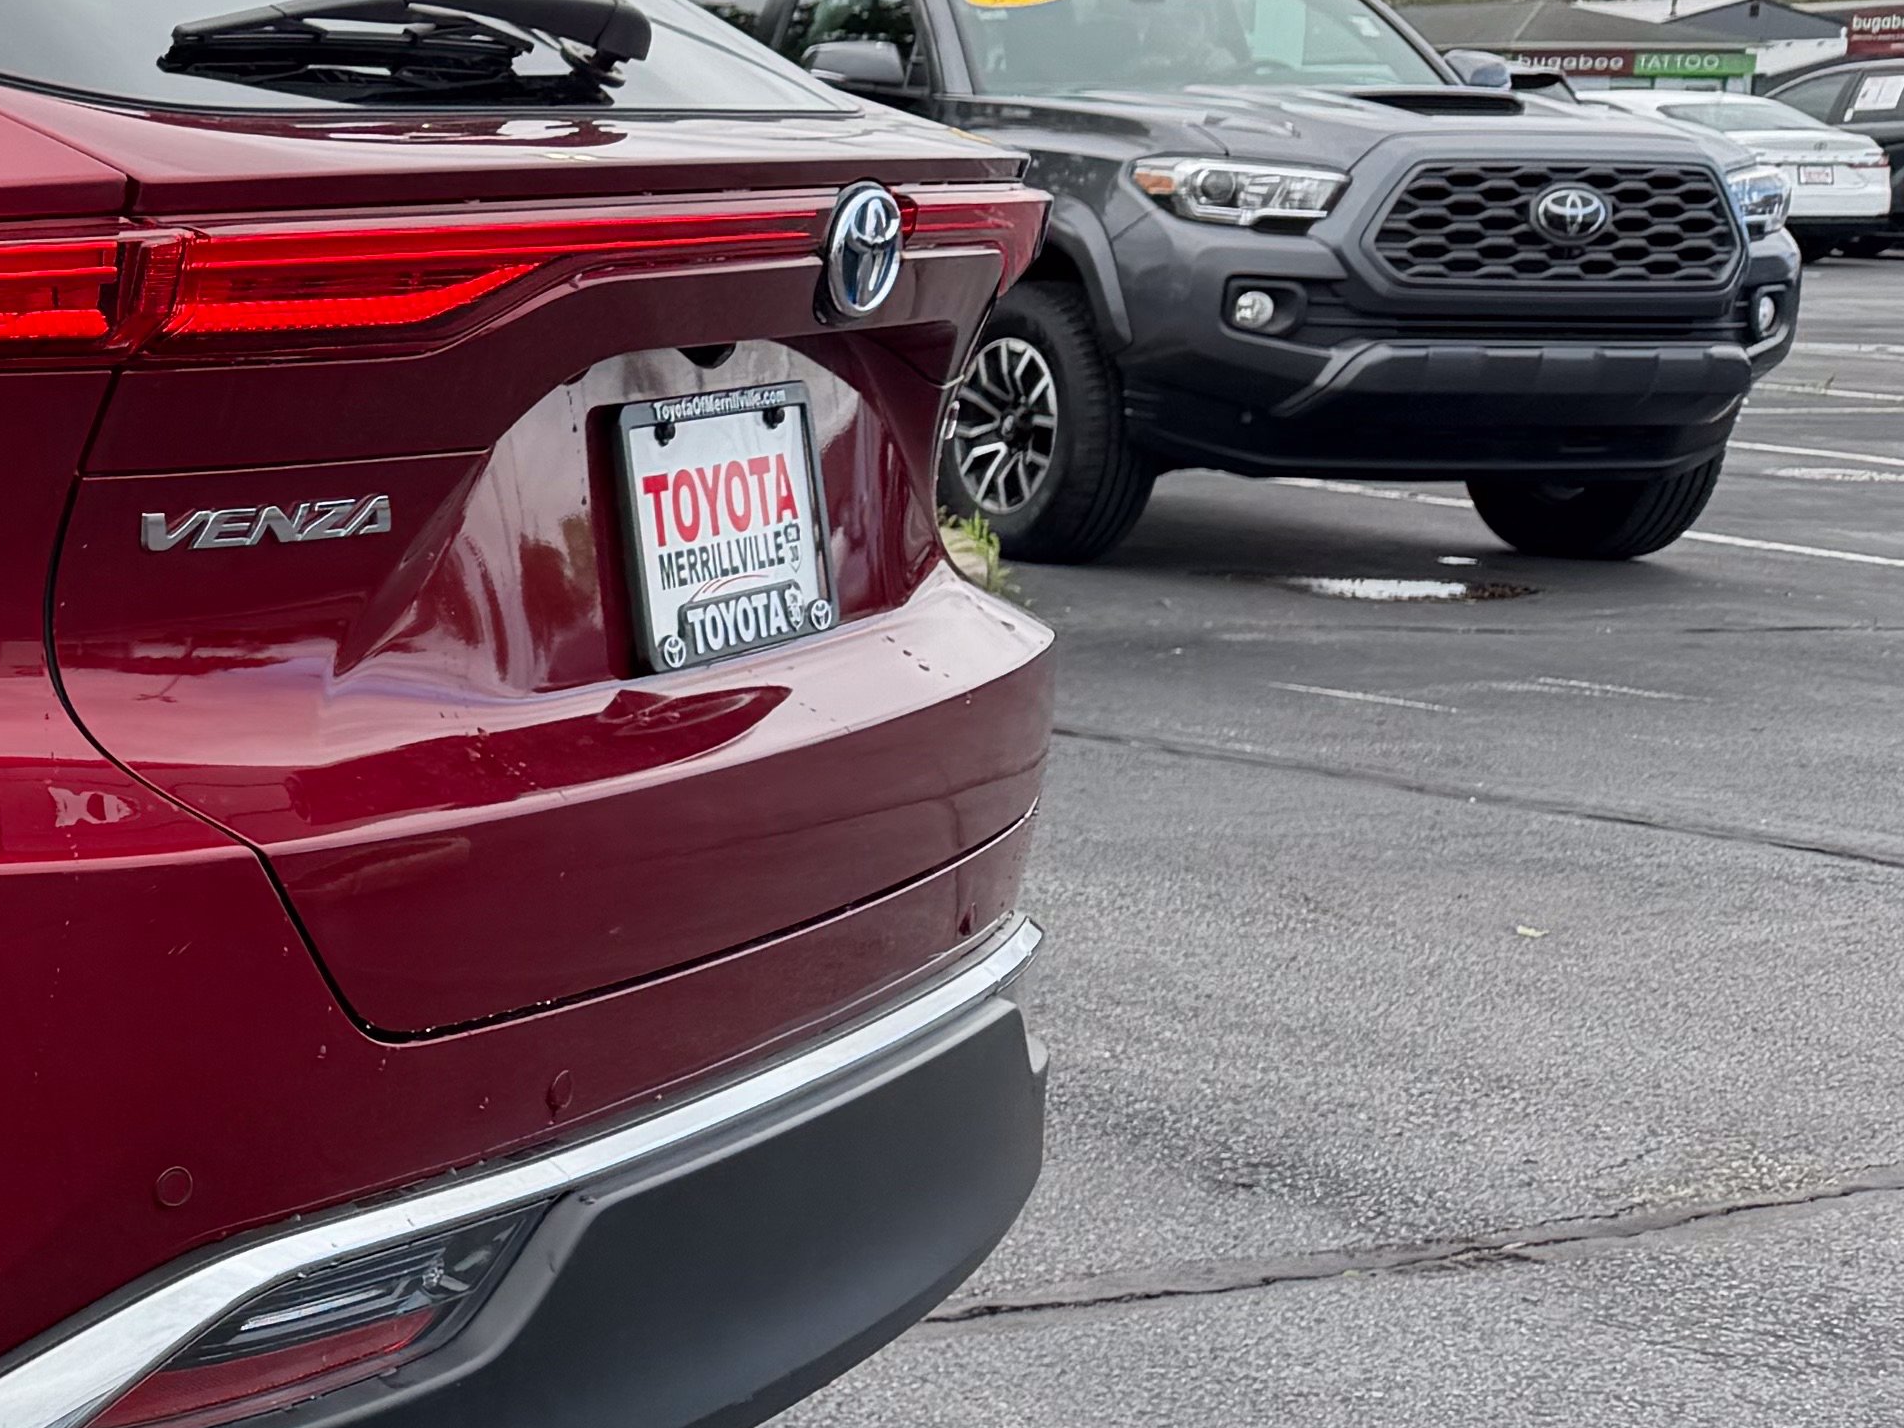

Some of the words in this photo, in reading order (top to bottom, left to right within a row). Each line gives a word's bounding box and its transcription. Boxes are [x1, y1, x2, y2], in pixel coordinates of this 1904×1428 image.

[1852, 14, 1904, 34] bugab
[1518, 54, 1624, 71] bugaboo
[1639, 54, 1720, 71] TATTOO
[140, 493, 392, 552] VENZA
[642, 453, 799, 548] TOYOTA
[657, 529, 785, 591] MERRILLVILLE
[686, 589, 789, 655] TOYOTA
